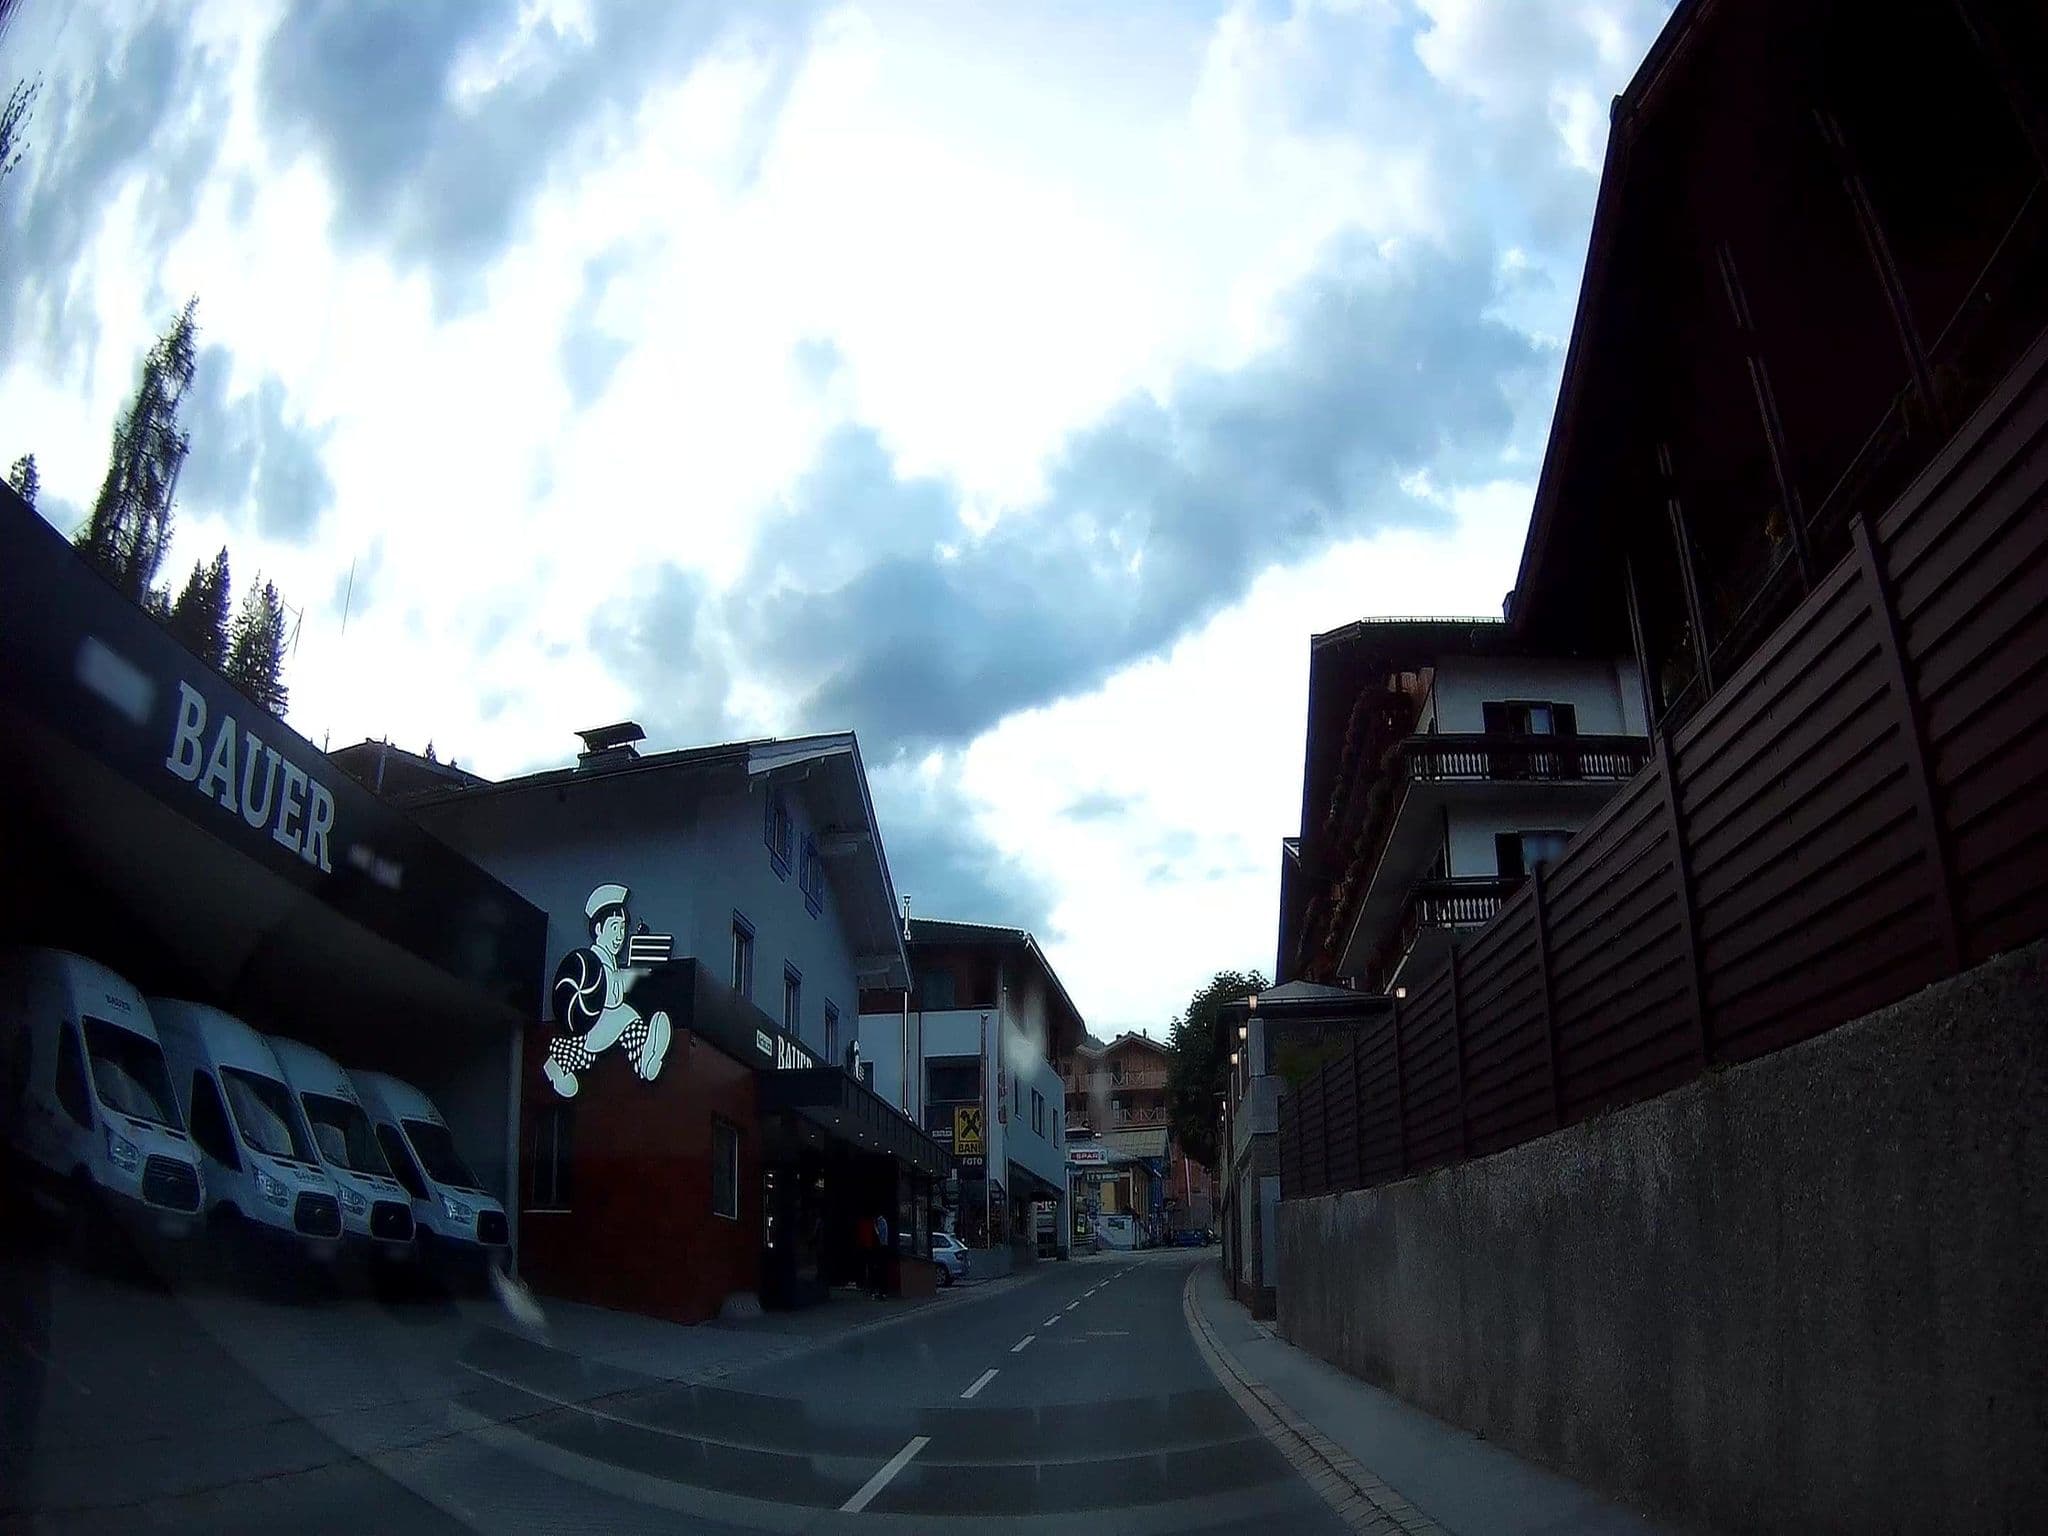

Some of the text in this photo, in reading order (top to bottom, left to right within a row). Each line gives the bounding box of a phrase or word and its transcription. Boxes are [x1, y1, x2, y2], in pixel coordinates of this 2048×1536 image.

[165, 679, 336, 875] BAUER
[1076, 1151, 1098, 1161] SPAR
[962, 1157, 983, 1166] FOTO
